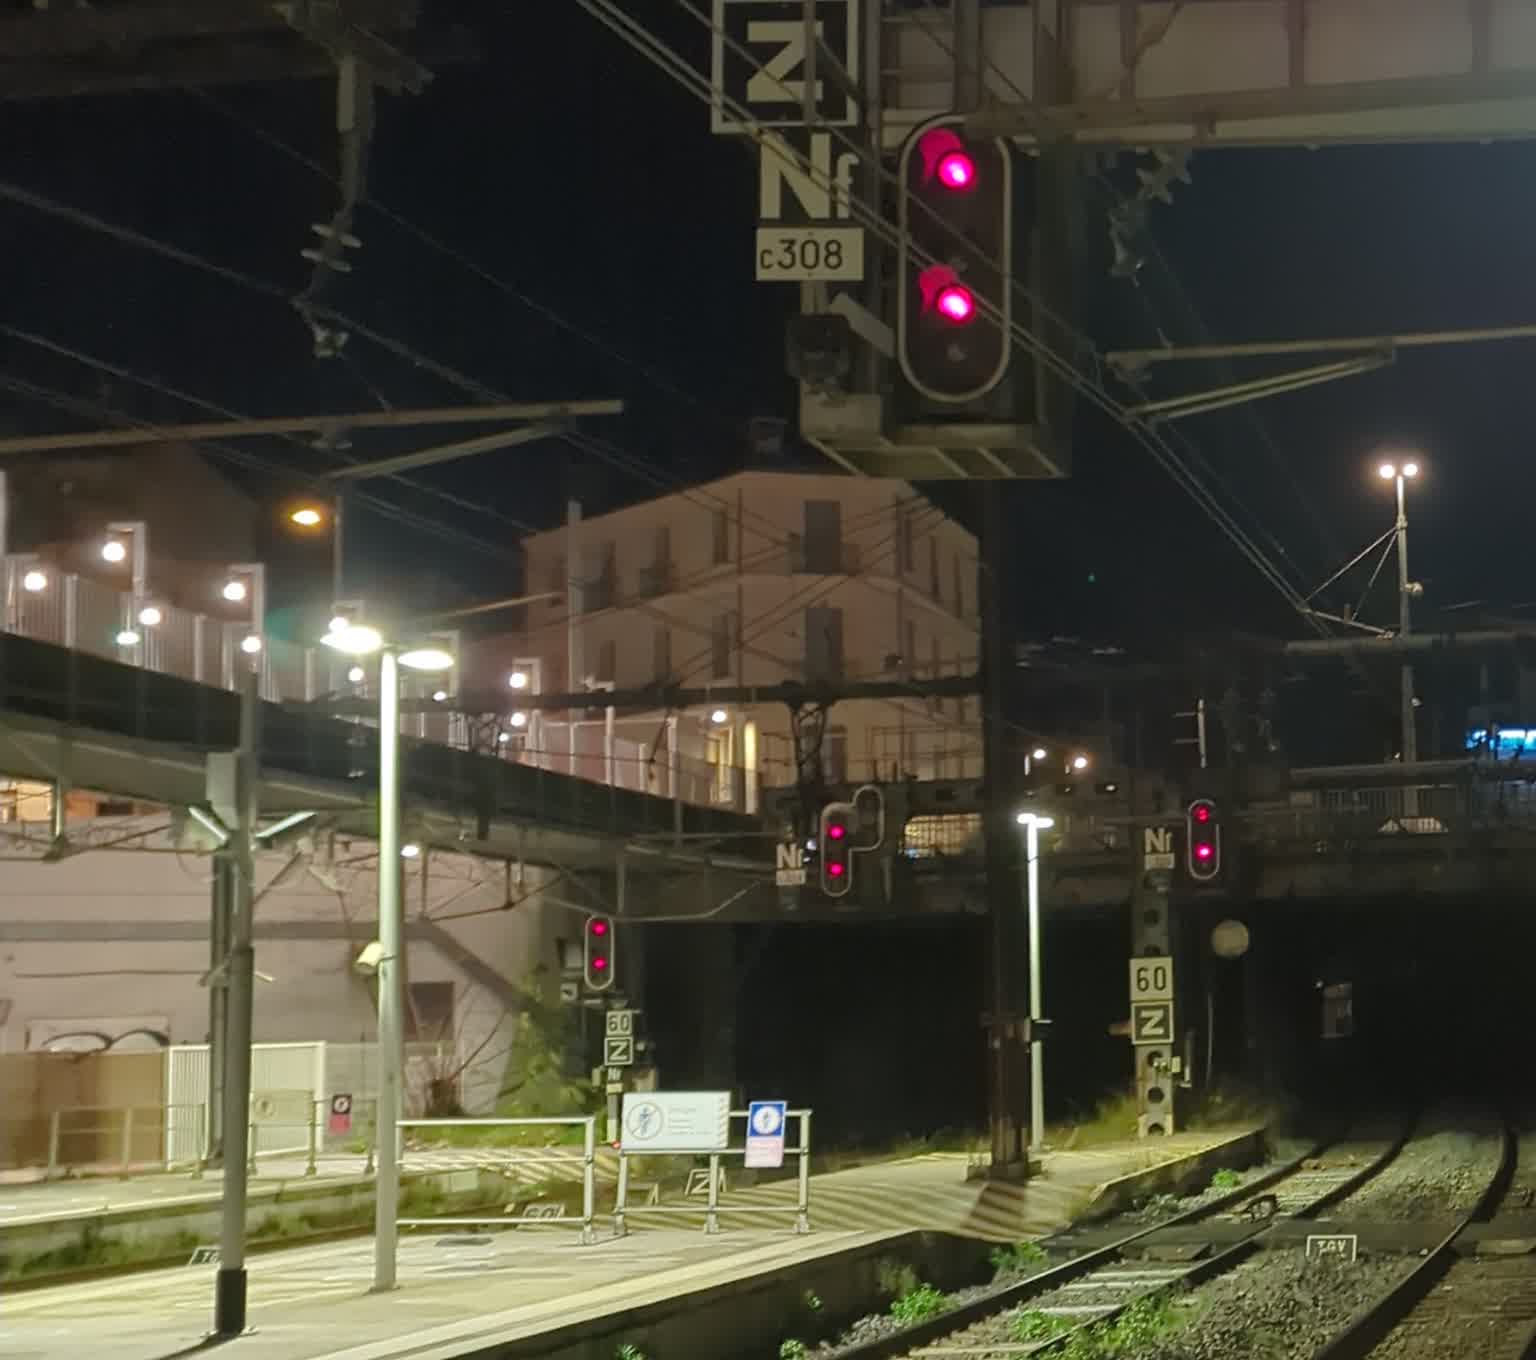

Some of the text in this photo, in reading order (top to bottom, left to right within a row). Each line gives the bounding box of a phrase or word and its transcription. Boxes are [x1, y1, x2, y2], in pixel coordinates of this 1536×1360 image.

[746, 19, 824, 103] Z
[759, 133, 860, 220] Nf
[1136, 965, 1167, 992] 60
[607, 1013, 630, 1032] 60
[1139, 1009, 1165, 1038] Z
[609, 1040, 629, 1061] Z
